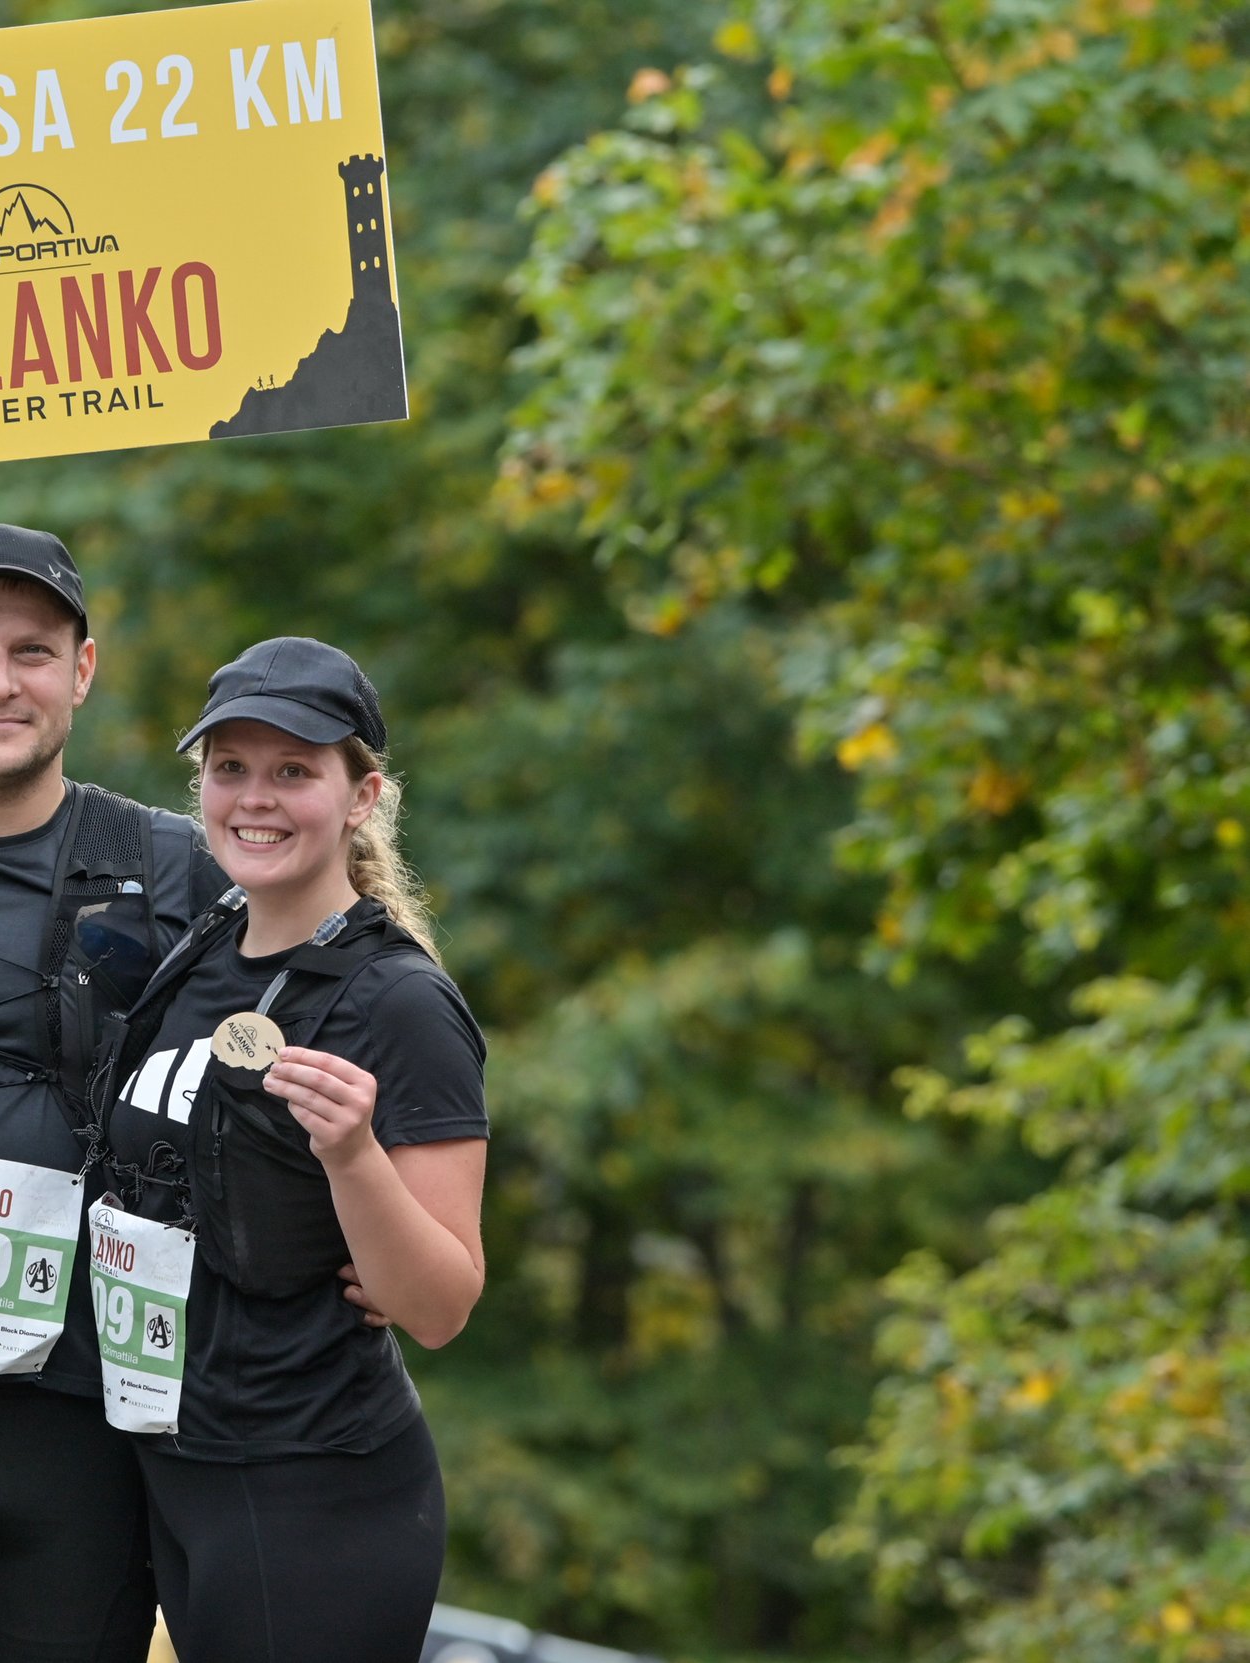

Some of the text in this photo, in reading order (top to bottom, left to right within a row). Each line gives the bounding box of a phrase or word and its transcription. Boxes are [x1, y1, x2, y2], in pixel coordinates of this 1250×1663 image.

[105, 54, 198, 144] 22
[230, 37, 343, 130] KM
[59, 384, 164, 417] TRAIL
[227, 1021, 255, 1058] AULANKO
[102, 1264, 119, 1278] TRAIL
[0, 1326, 48, 1339] Black Diamond
[102, 1344, 138, 1364] Orimattila
[126, 1381, 168, 1395] Black Diamond
